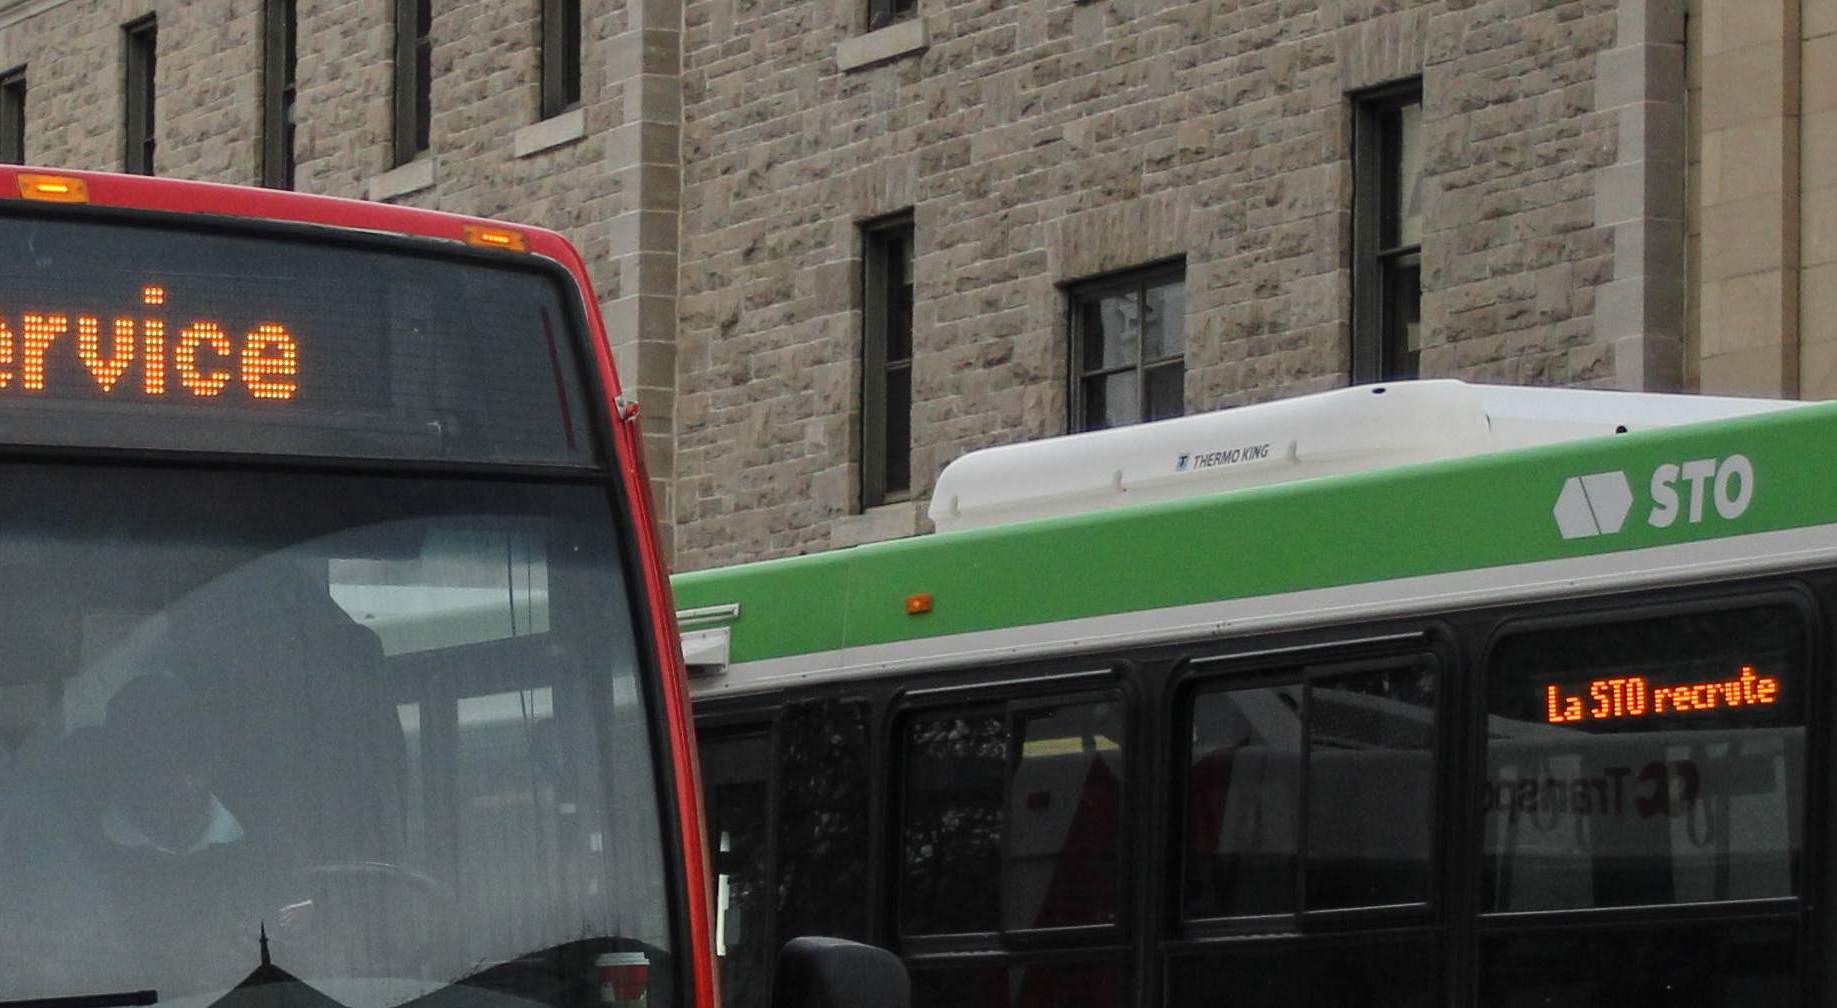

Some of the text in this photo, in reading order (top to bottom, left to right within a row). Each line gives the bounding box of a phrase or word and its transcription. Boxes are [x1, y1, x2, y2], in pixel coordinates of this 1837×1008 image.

[1193, 443, 1271, 470] THERMO KING
[1647, 454, 1755, 529] STO
[1547, 665, 1777, 723] La STO recrute
